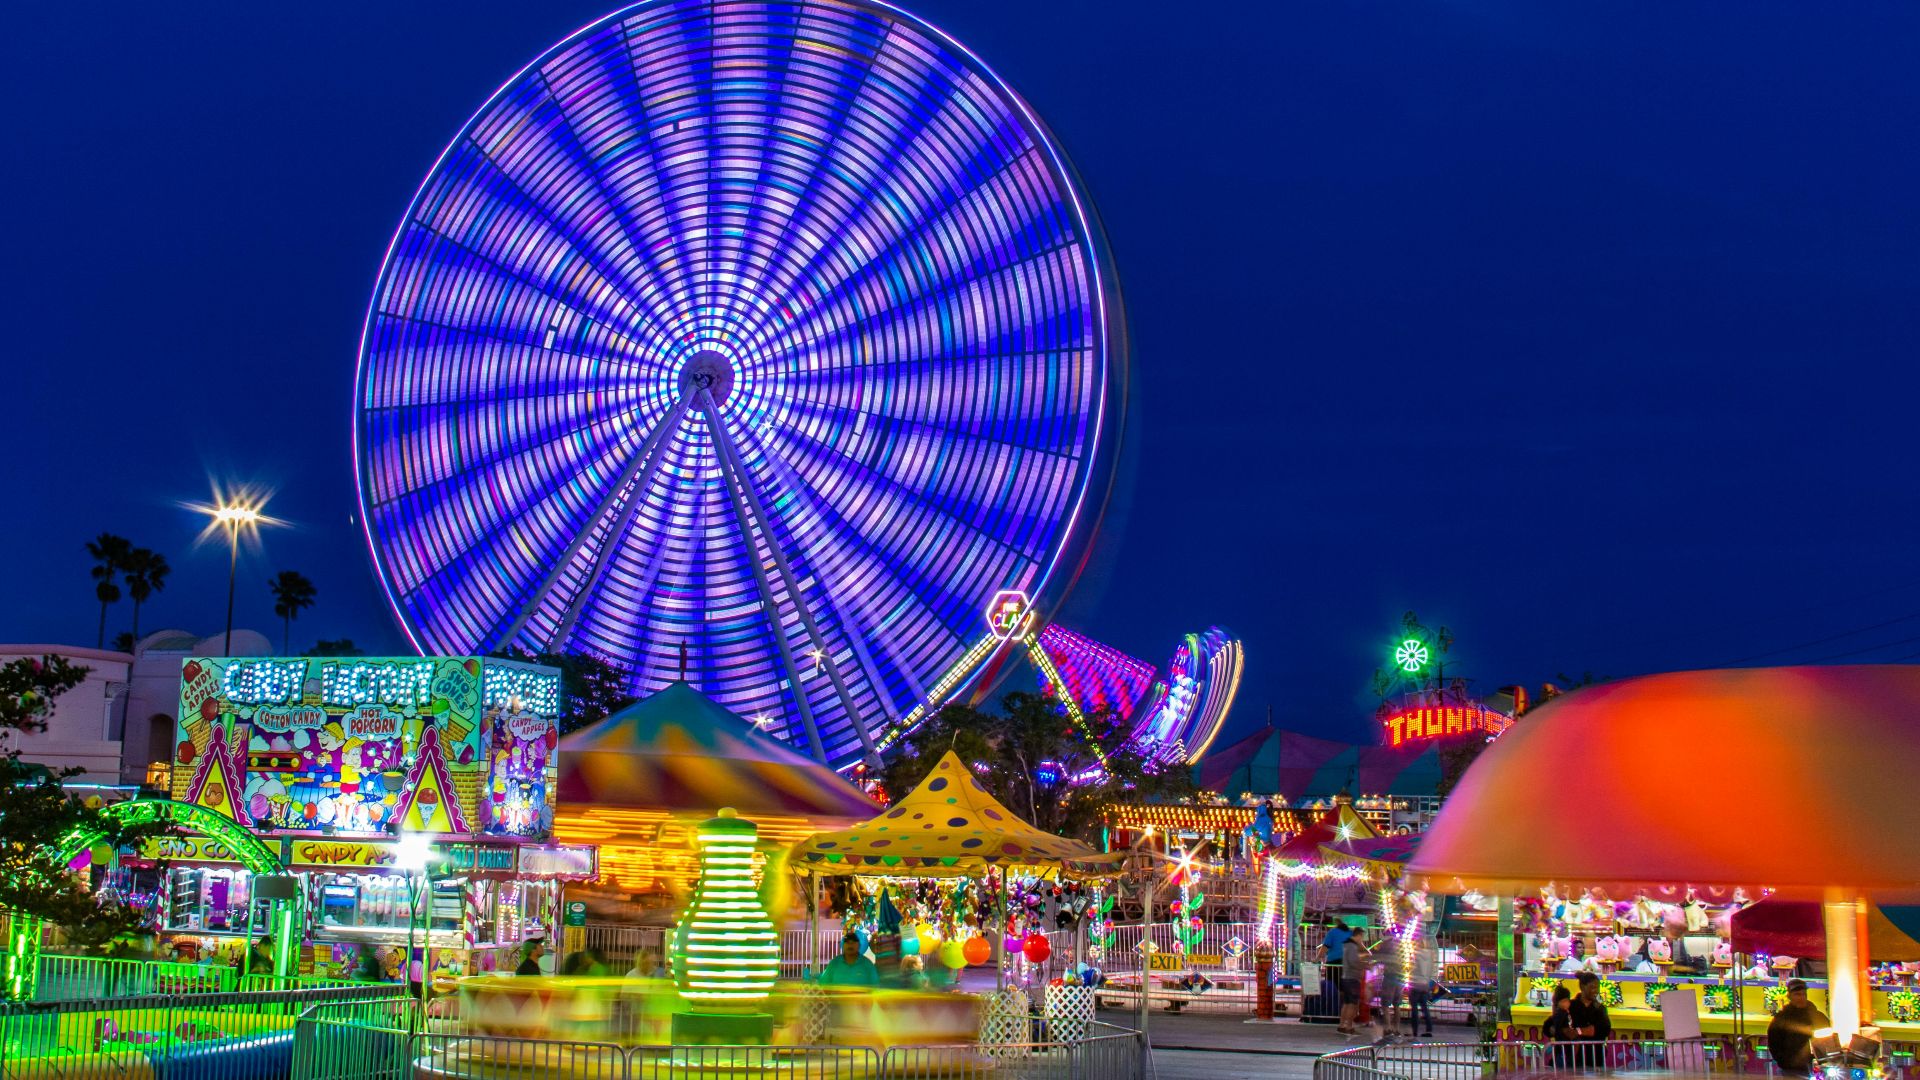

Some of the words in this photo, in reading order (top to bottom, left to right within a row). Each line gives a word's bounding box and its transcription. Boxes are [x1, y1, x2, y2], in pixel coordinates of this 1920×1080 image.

[184, 668, 212, 700] CANDY
[224, 660, 308, 704] CANDY
[322, 661, 436, 706] FACTORY
[447, 670, 471, 694] SNO
[189, 680, 220, 711] APPLES
[435, 679, 468, 711] CONES
[260, 710, 290, 727] COTTON
[293, 711, 320, 725] CANDY
[361, 709, 381, 718] HOT
[512, 718, 531, 728] CANDY
[351, 718, 396, 734] POPCORN
[522, 722, 545, 735] APPLES
[158, 839, 197, 858] SNO
[202, 840, 236, 860] CO
[300, 842, 362, 864] CANDY
[478, 849, 513, 868] DRINKS
[1150, 954, 1179, 969] EXIT
[1447, 965, 1479, 980] ENTER
